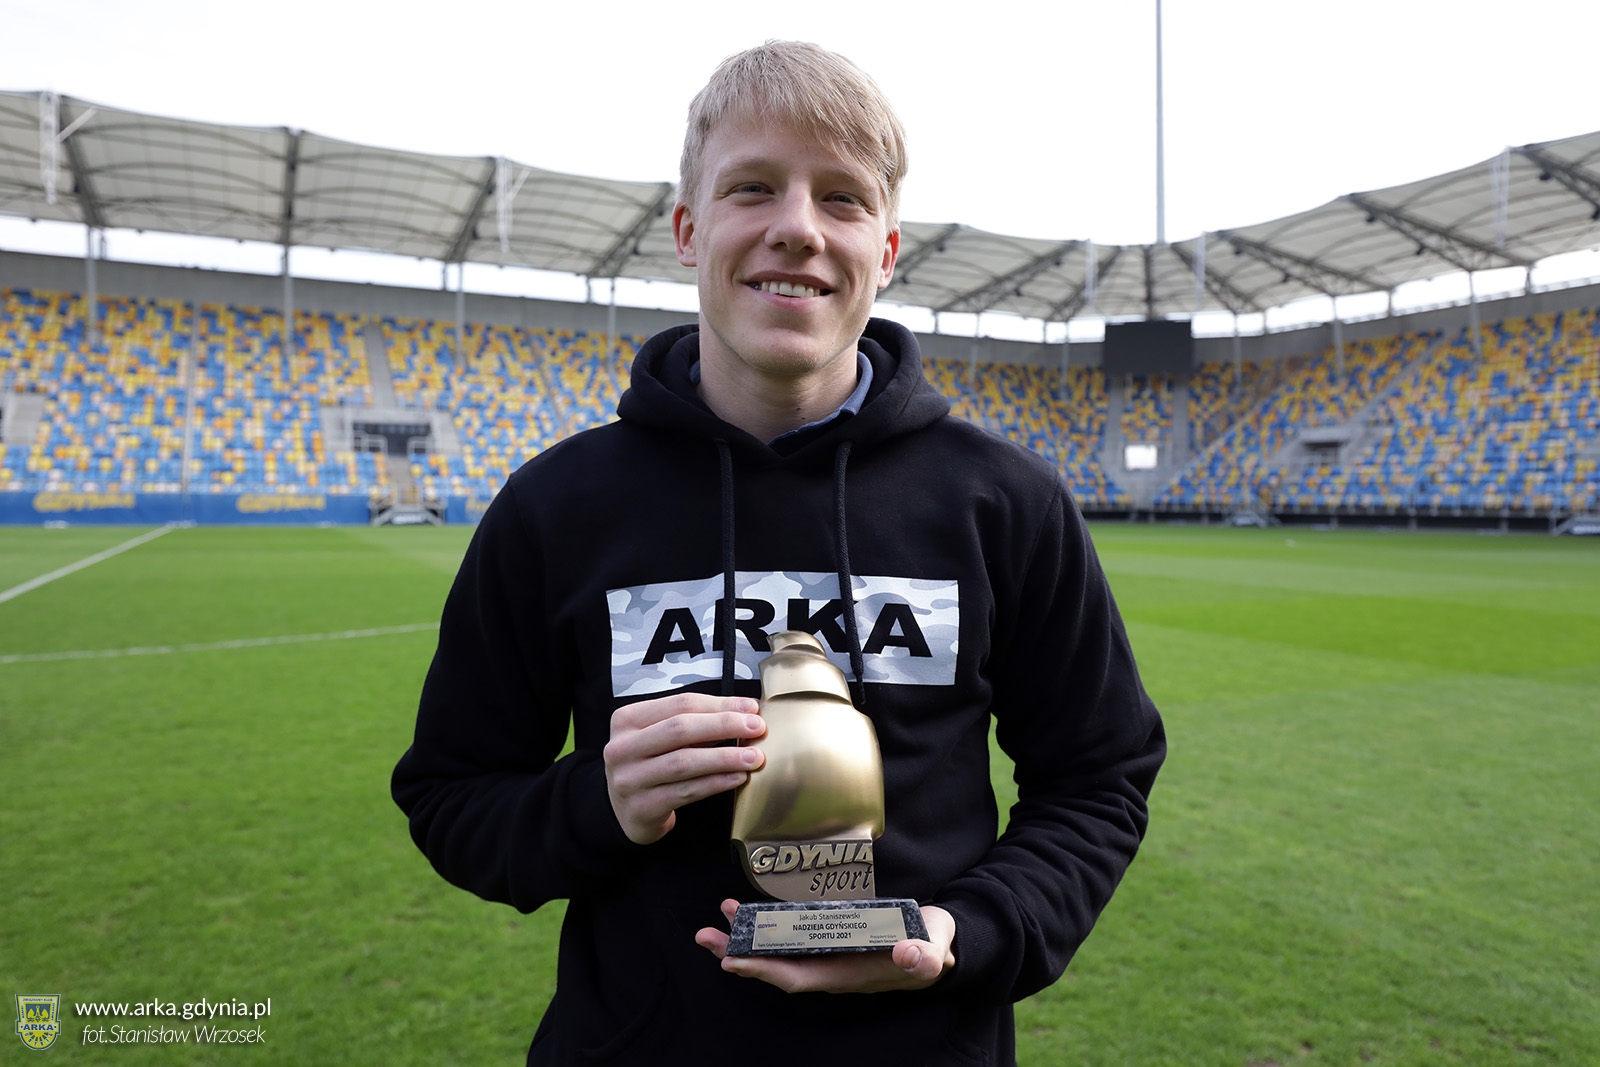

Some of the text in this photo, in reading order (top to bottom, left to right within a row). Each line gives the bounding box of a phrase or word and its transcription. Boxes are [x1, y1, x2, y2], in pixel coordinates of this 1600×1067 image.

[641, 598, 933, 666] ARKA
[750, 842, 874, 875] GDYNIA
[809, 865, 873, 898] sport
[792, 920, 868, 932] NADZIEJA GDYŃSKIEGO
[799, 911, 861, 922] Jakub Staniszewski
[808, 931, 852, 941] SPORTU 2021
